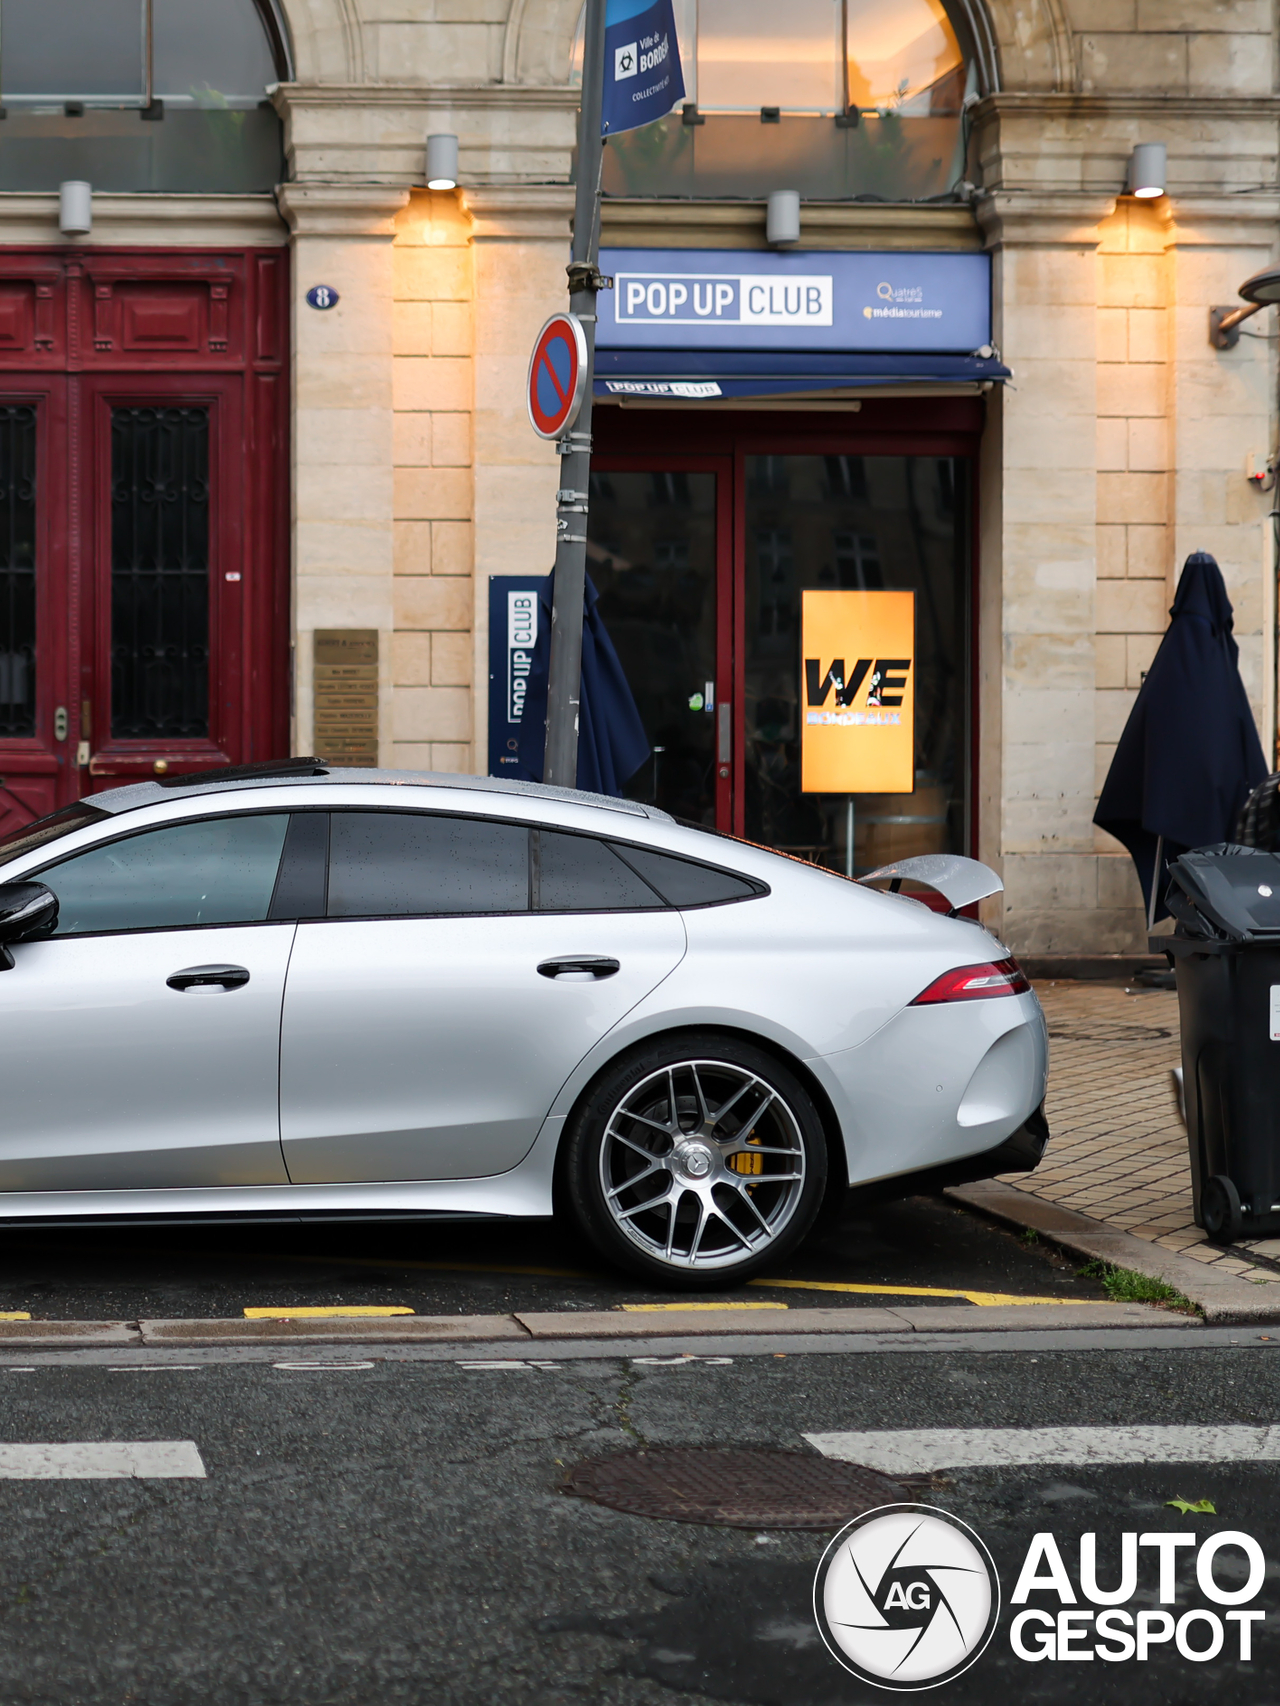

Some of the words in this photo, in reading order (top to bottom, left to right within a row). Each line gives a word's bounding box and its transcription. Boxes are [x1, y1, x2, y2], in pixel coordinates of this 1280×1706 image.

[316, 287, 330, 307] 8
[627, 281, 688, 316] POP
[693, 282, 734, 316] UP
[748, 286, 823, 315] CLUB
[873, 306, 943, 318] médiatourisme
[614, 382, 646, 392] POP
[647, 383, 669, 393] UP
[676, 385, 716, 394] CLUB
[514, 598, 532, 643] CLUB
[513, 650, 532, 677] UP
[805, 659, 912, 708] WE
